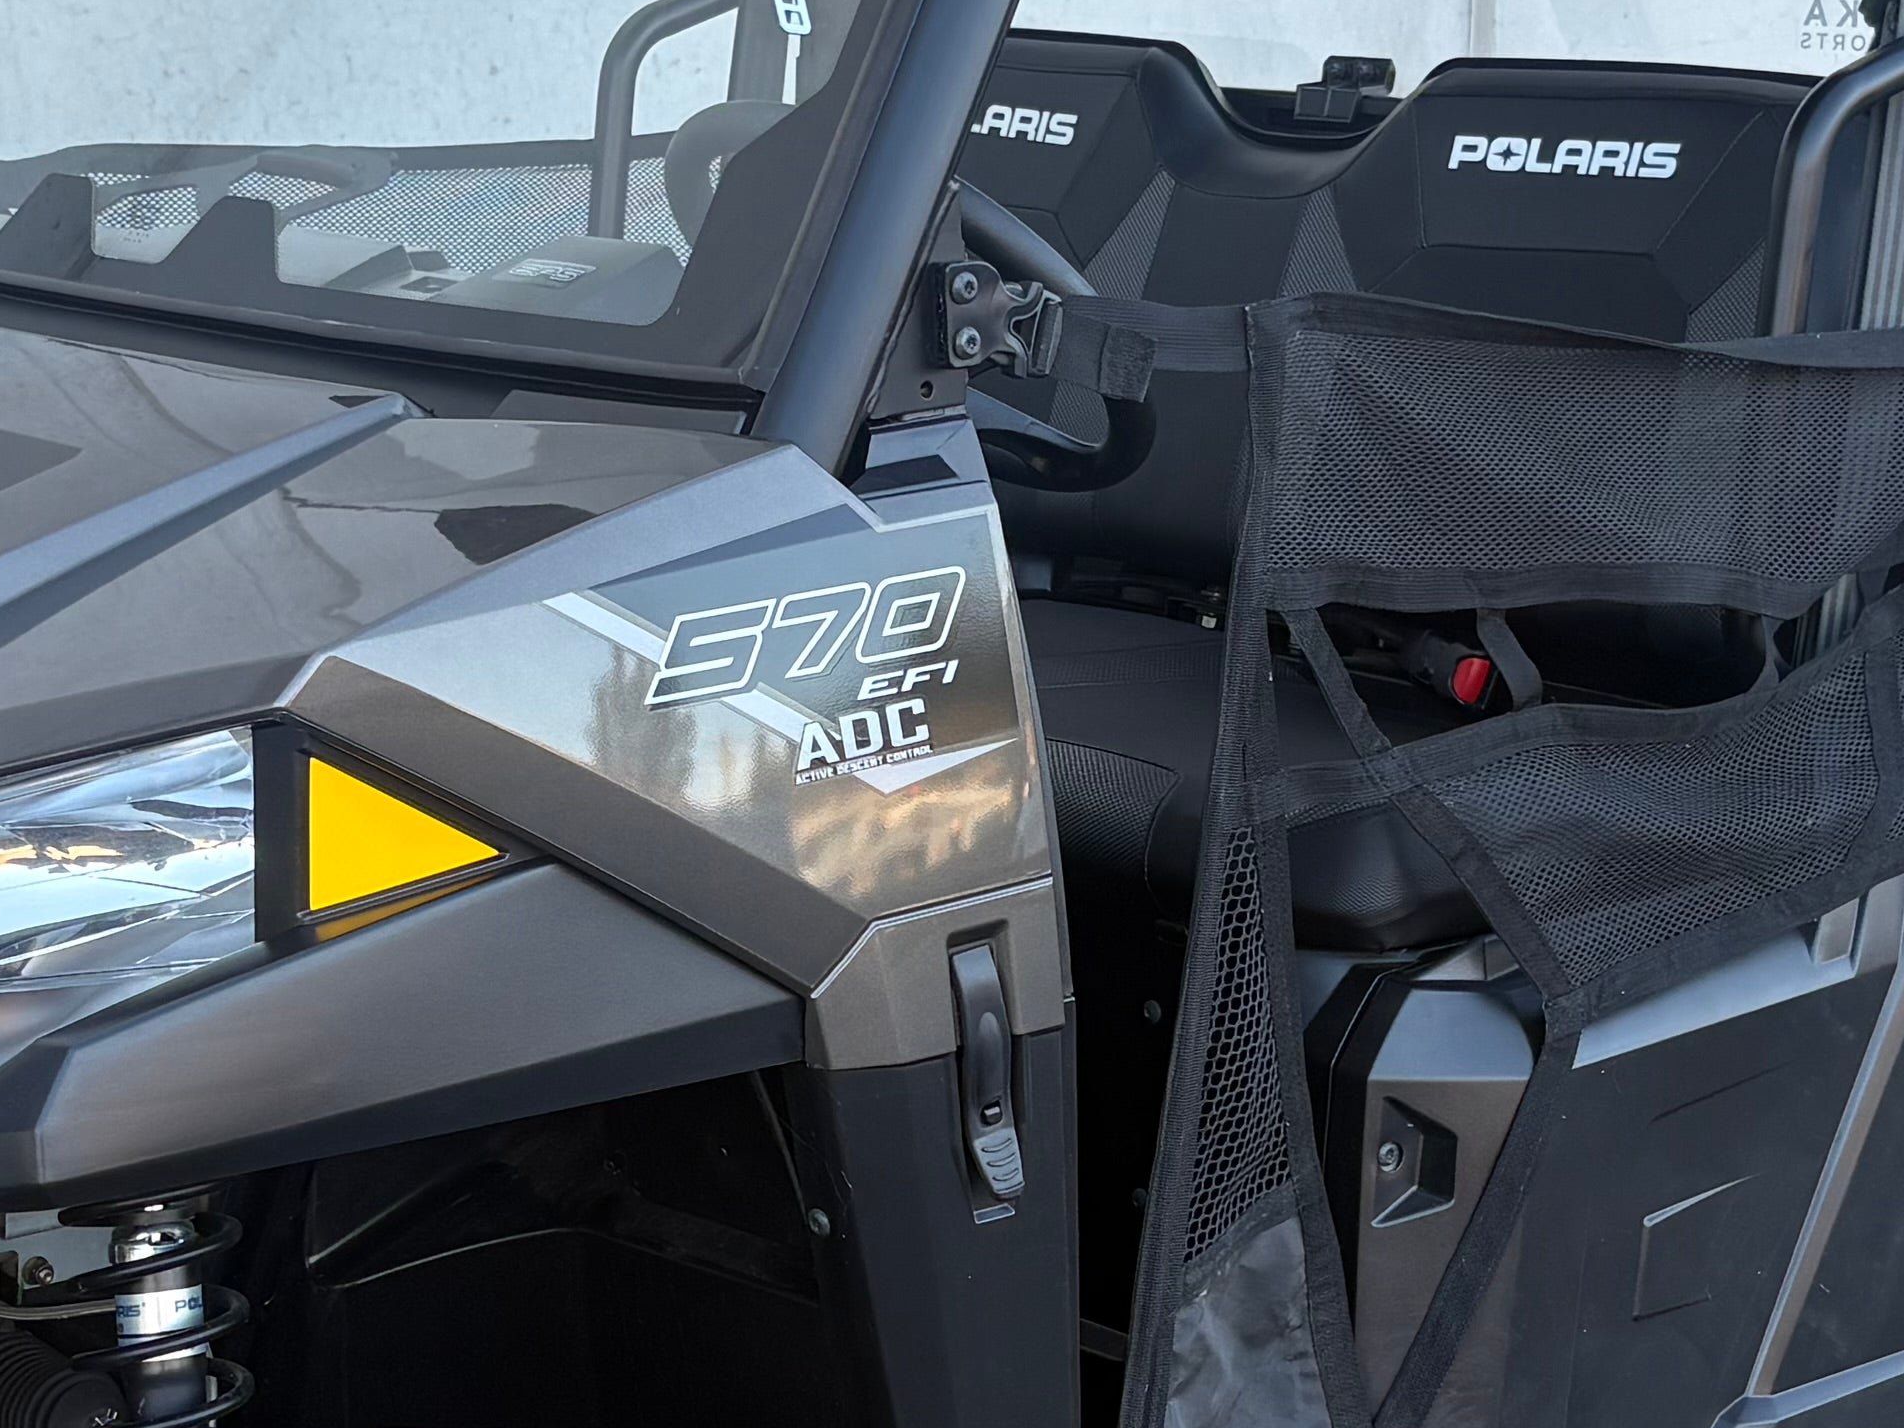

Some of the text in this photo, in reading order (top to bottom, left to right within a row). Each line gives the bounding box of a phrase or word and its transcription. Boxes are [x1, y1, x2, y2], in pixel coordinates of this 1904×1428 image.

[970, 104, 1078, 146] ARIS
[1448, 134, 1681, 179] POLARIS
[644, 565, 967, 706] 570
[856, 659, 960, 701] EFI
[798, 698, 930, 771] ADC
